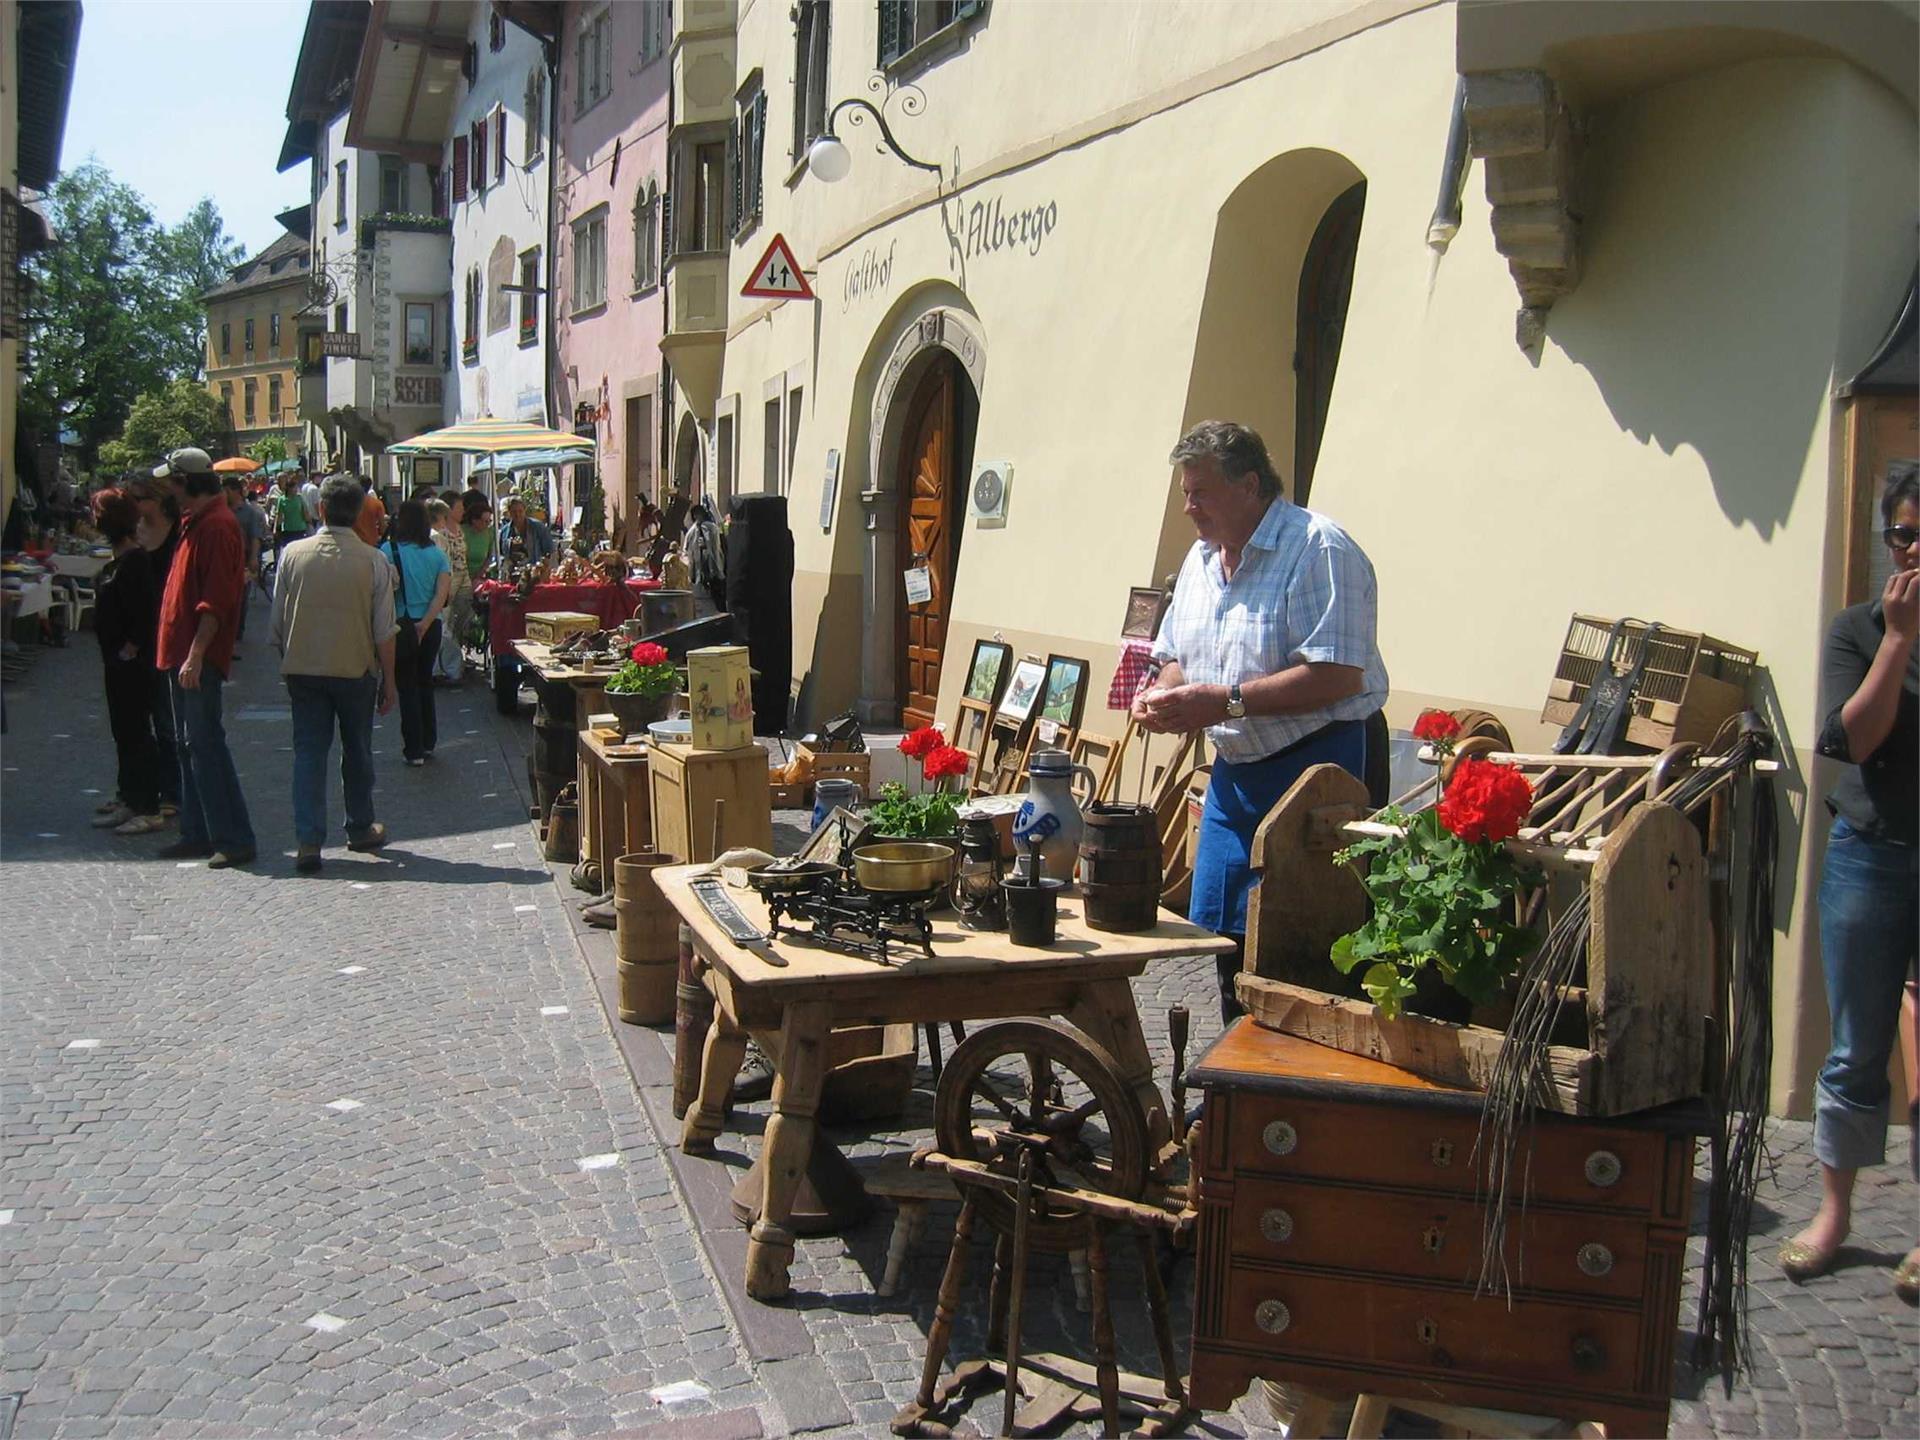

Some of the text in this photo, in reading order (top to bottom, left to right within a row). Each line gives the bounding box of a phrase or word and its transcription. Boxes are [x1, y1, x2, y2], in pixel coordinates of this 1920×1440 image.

[965, 195, 1058, 260] Albergo
[323, 344, 359, 355] ZIMMER
[394, 376, 442, 391] ROTER
[394, 391, 443, 405] ADLER
